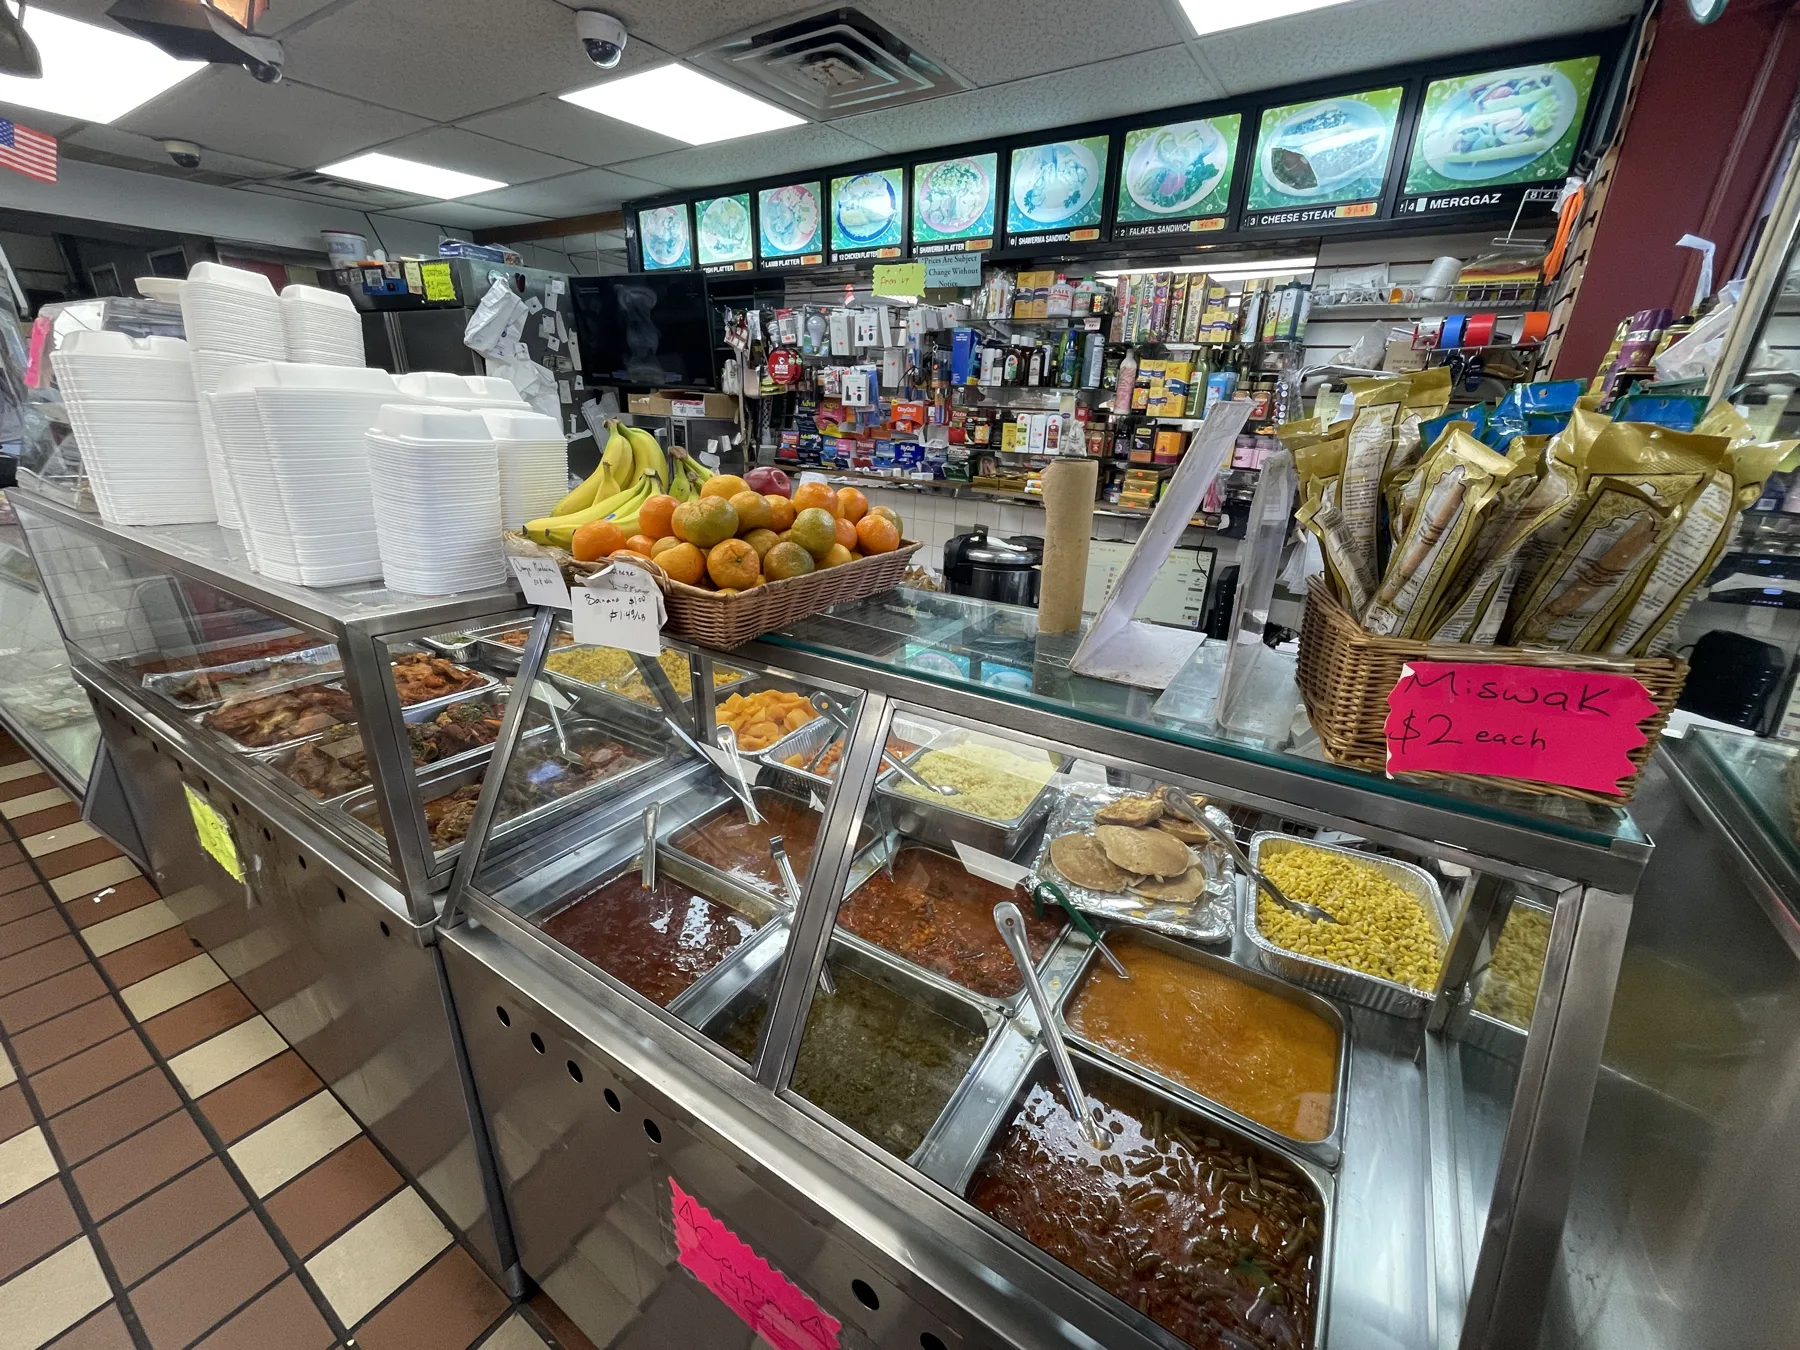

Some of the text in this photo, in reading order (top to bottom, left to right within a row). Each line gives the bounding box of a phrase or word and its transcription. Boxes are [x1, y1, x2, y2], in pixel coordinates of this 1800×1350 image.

[1429, 193, 1502, 210] MERGGAZ
[1261, 212, 1300, 225] CHEESE
[1301, 209, 1336, 221] STEAK
[1129, 226, 1156, 236] FALAFEL
[944, 243, 965, 251] PLATTER
[779, 258, 800, 266] PLATTER
[942, 256, 954, 264] Are
[953, 255, 978, 264] Subject
[713, 265, 734, 273] PLATTER
[928, 267, 978, 277] Change Without
[1388, 709, 1547, 755] $2 each
